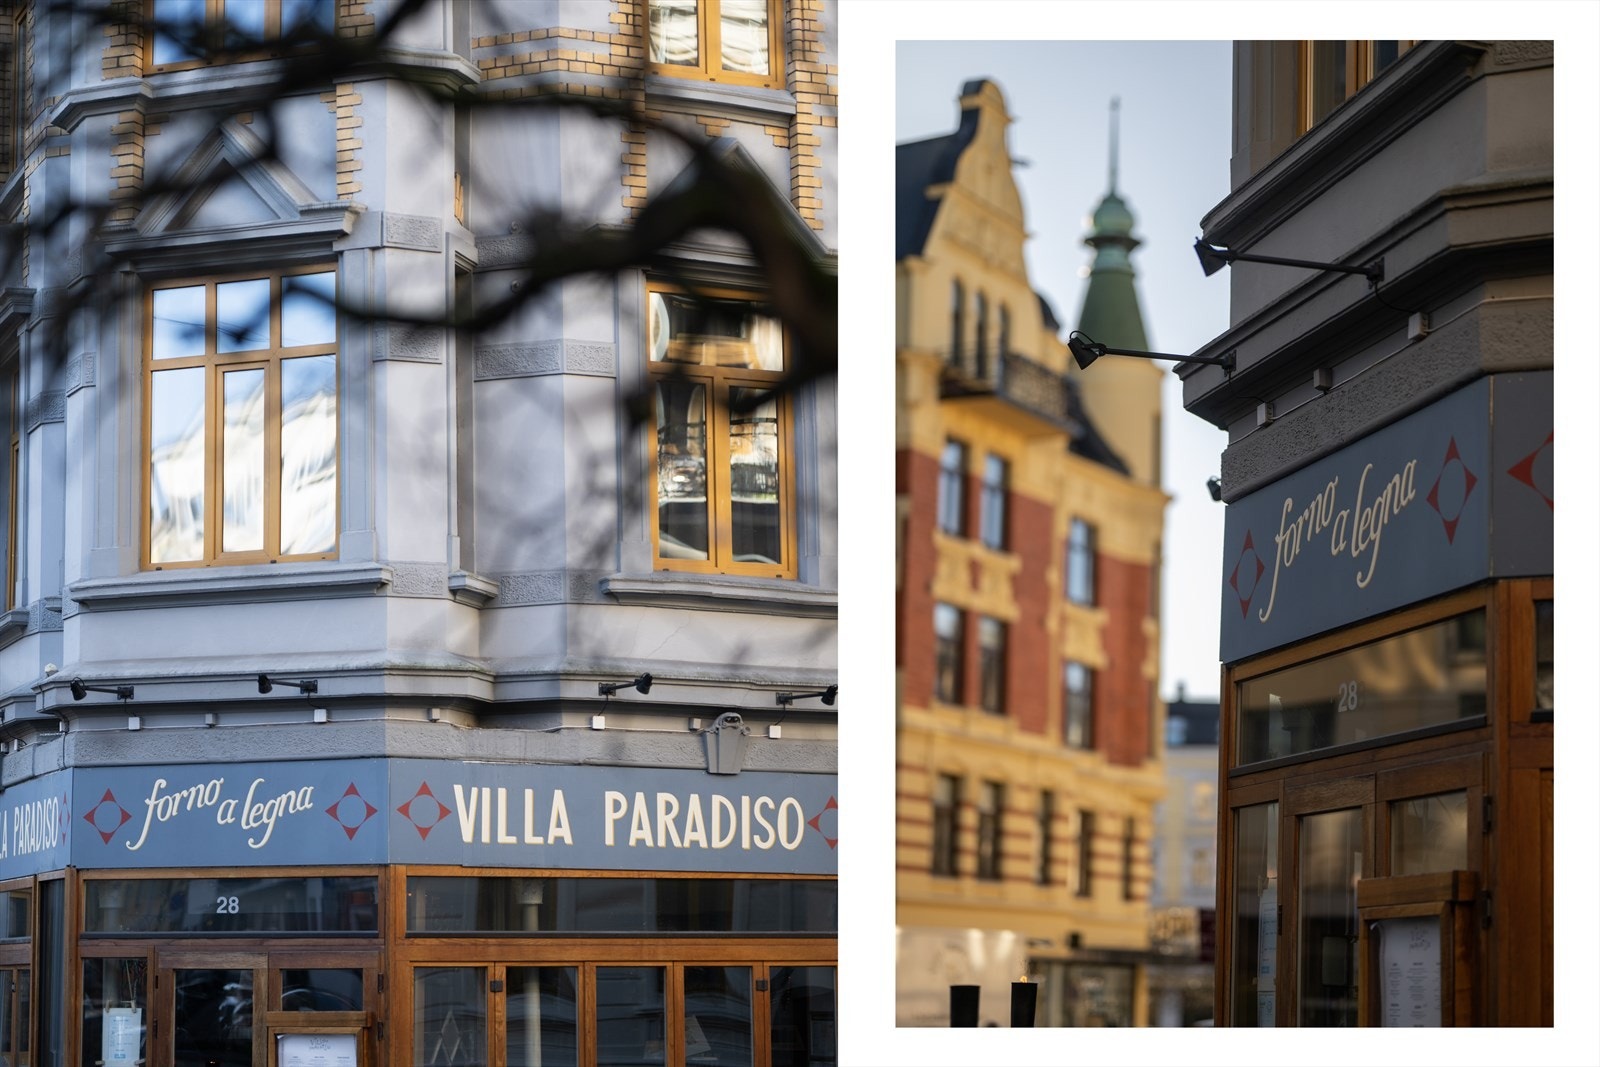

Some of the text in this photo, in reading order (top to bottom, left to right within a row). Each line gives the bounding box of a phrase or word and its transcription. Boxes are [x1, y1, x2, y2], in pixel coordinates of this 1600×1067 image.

[1258, 459, 1417, 623] forno a legna
[1337, 680, 1358, 713] 28
[13, 796, 59, 857] PARADISO
[126, 777, 315, 851] forno a legna
[453, 784, 806, 851] VILLA PARADISO
[216, 896, 240, 915] 28
